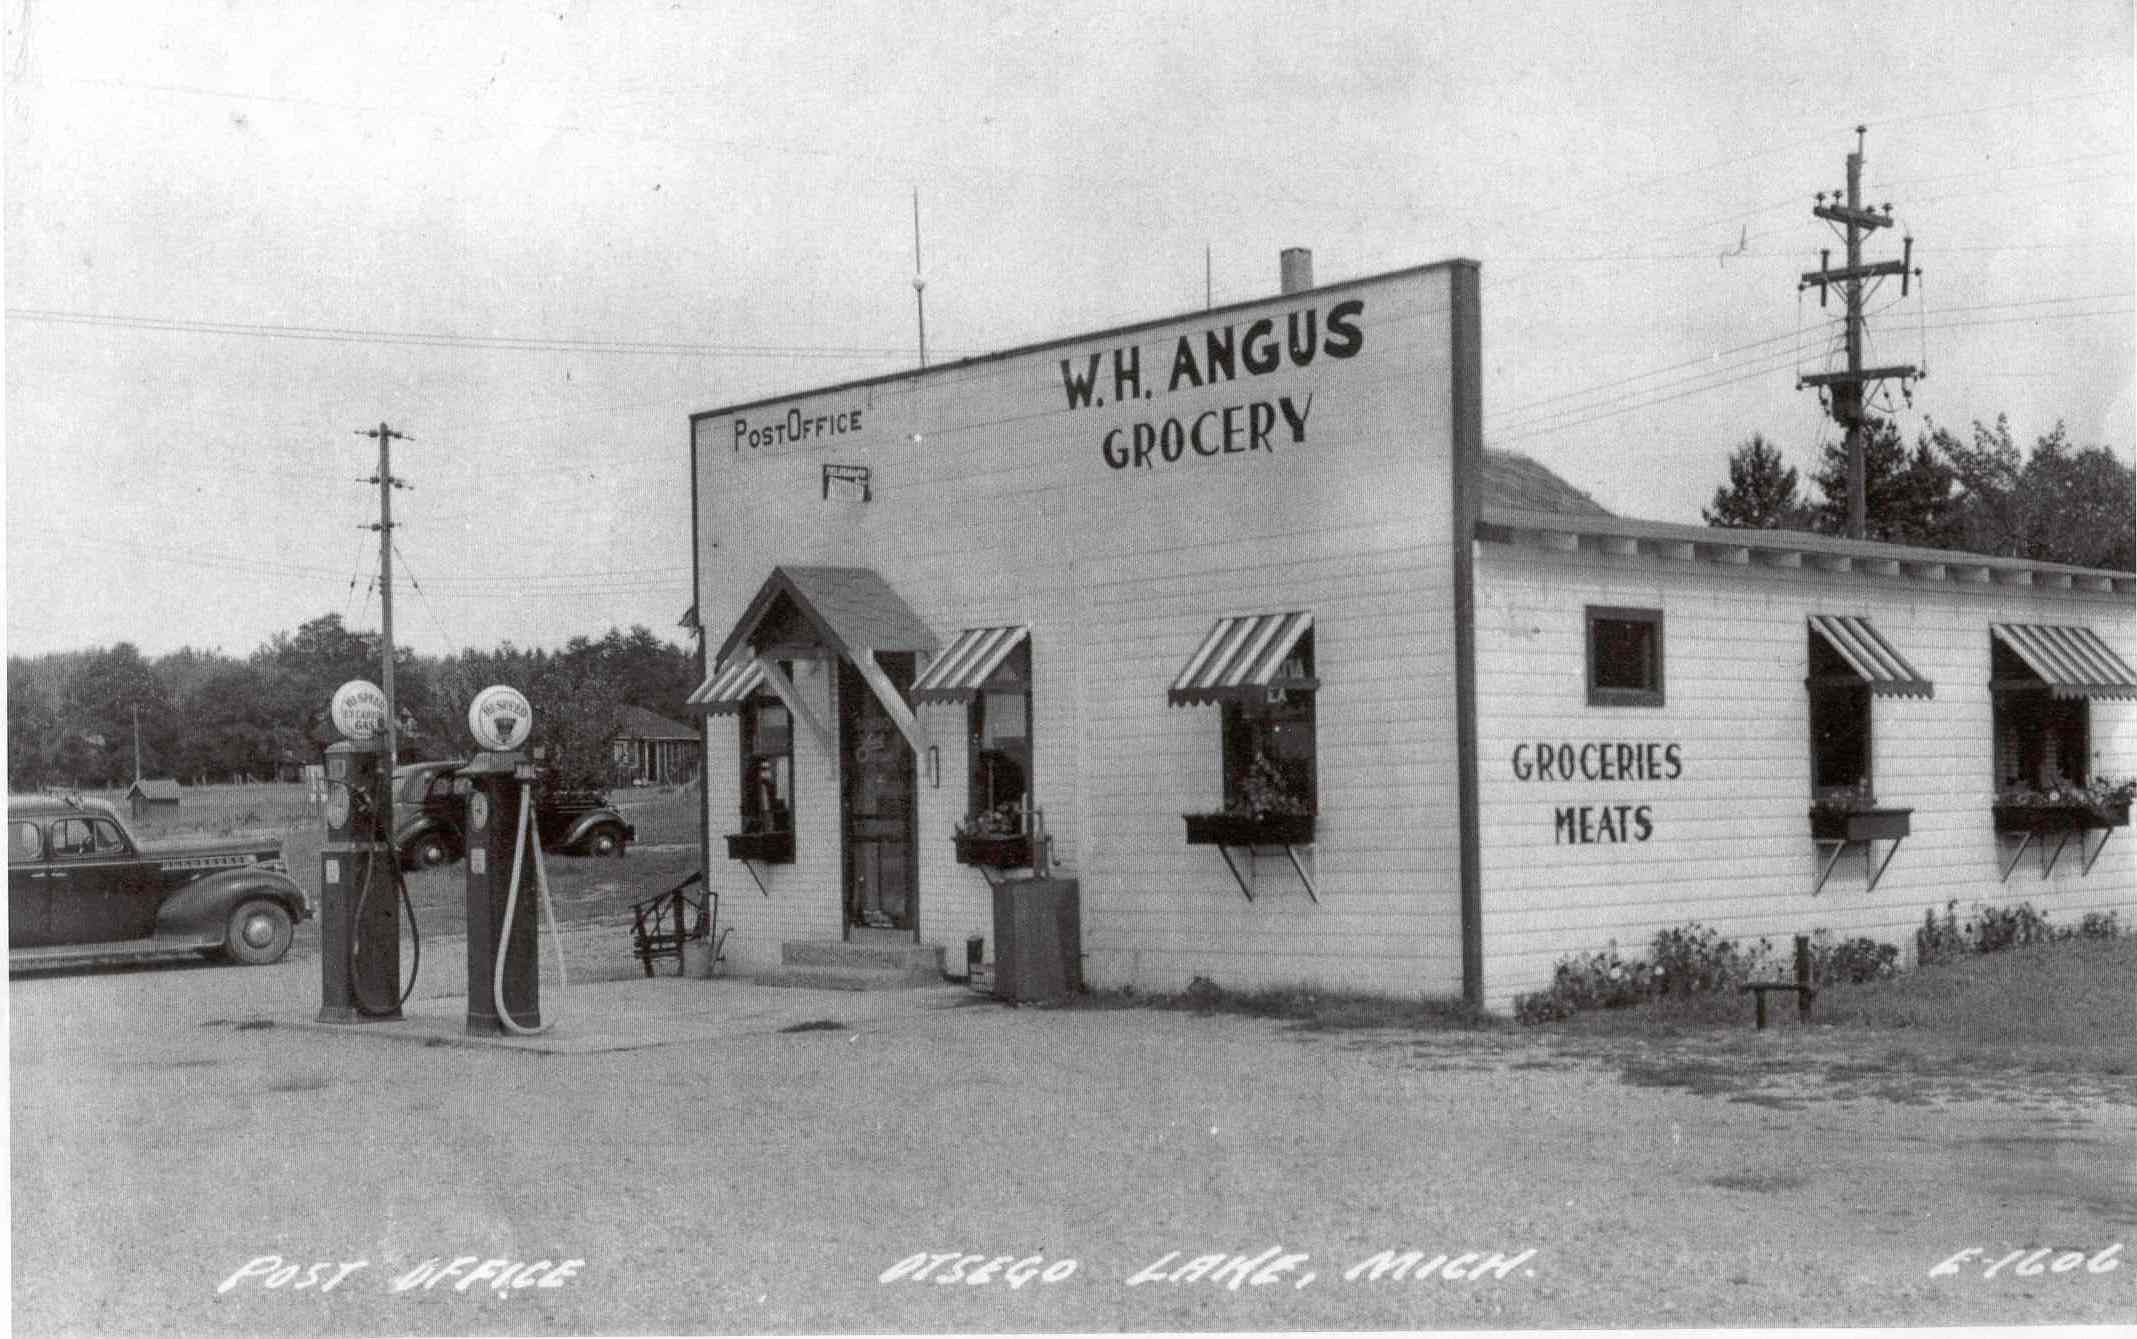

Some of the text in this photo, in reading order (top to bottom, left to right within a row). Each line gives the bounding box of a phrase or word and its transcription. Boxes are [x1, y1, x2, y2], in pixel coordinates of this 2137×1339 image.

[1167, 299, 1364, 392] ANGUS
[1102, 392, 1312, 469] GROCERY
[1512, 742, 1682, 781] GROCERIES
[1555, 805, 1654, 845] MEATS
